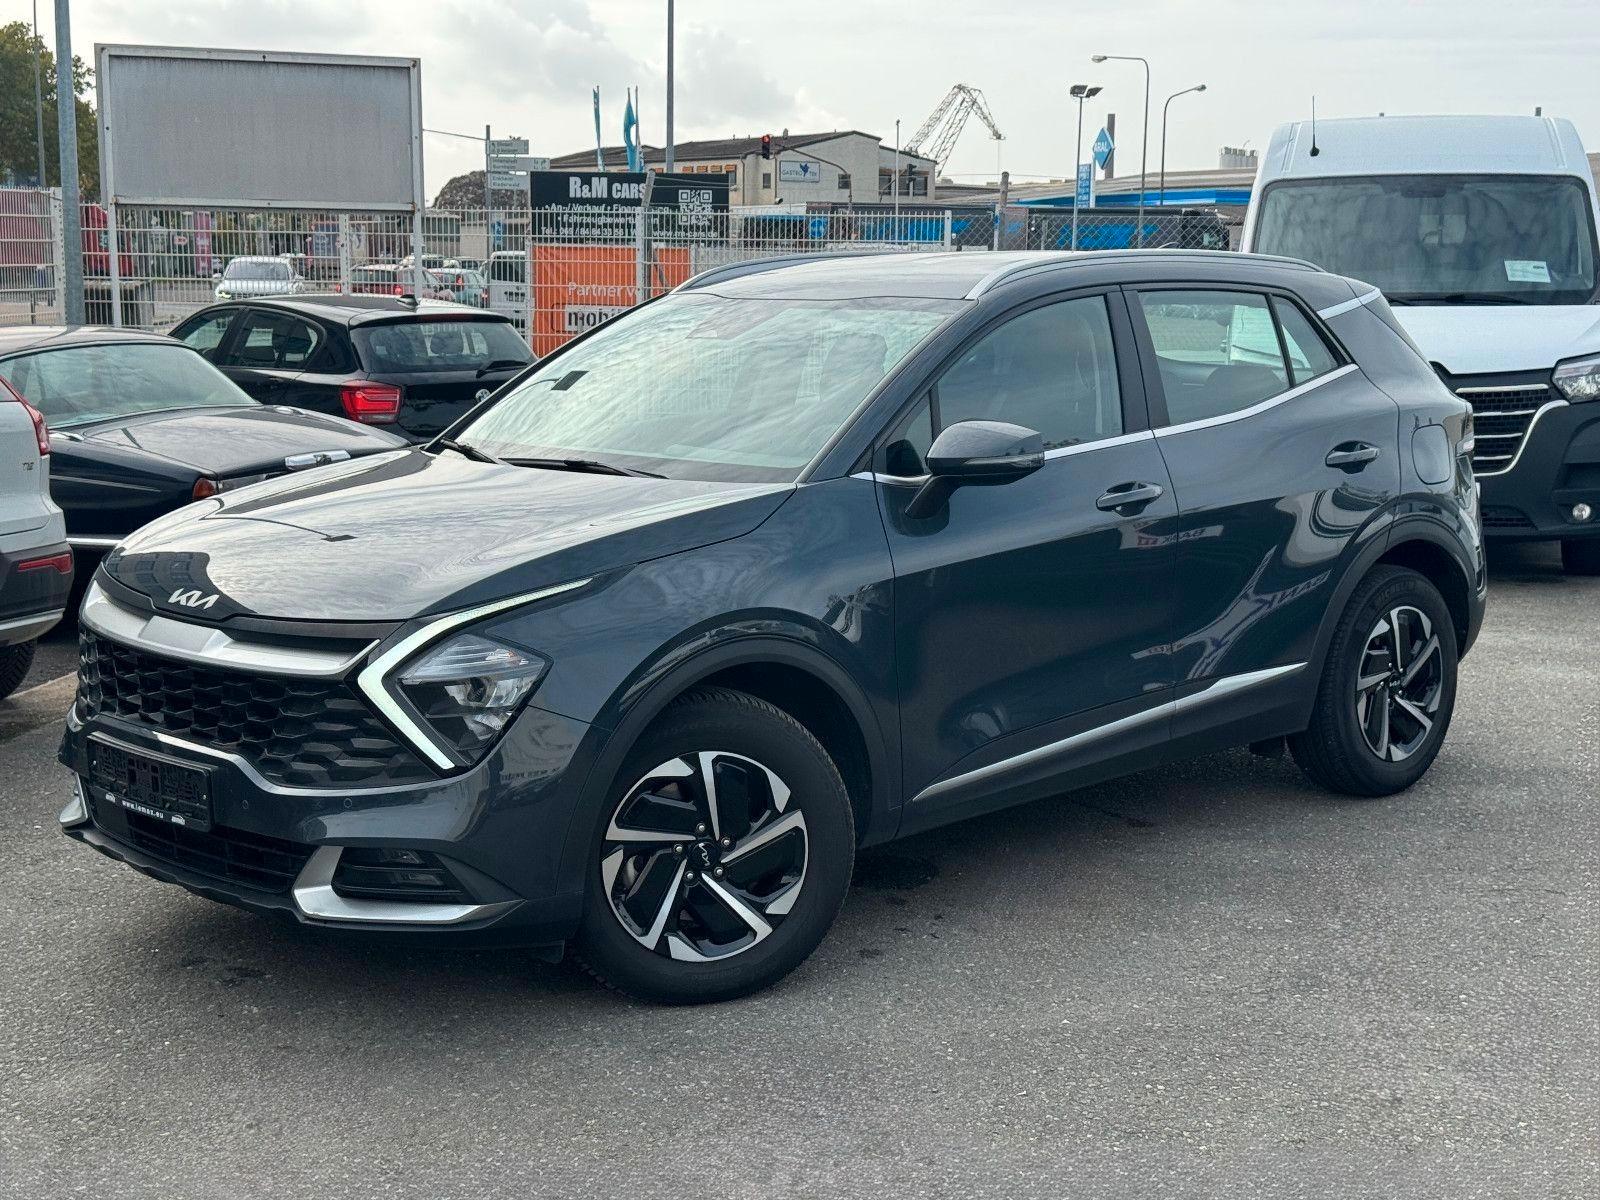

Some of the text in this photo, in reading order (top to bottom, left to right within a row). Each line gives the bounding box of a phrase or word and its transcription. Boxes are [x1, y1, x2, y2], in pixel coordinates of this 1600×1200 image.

[569, 176, 645, 199] R&M CARS
[572, 203, 606, 213] Verkauf
[568, 281, 622, 297] Partner
